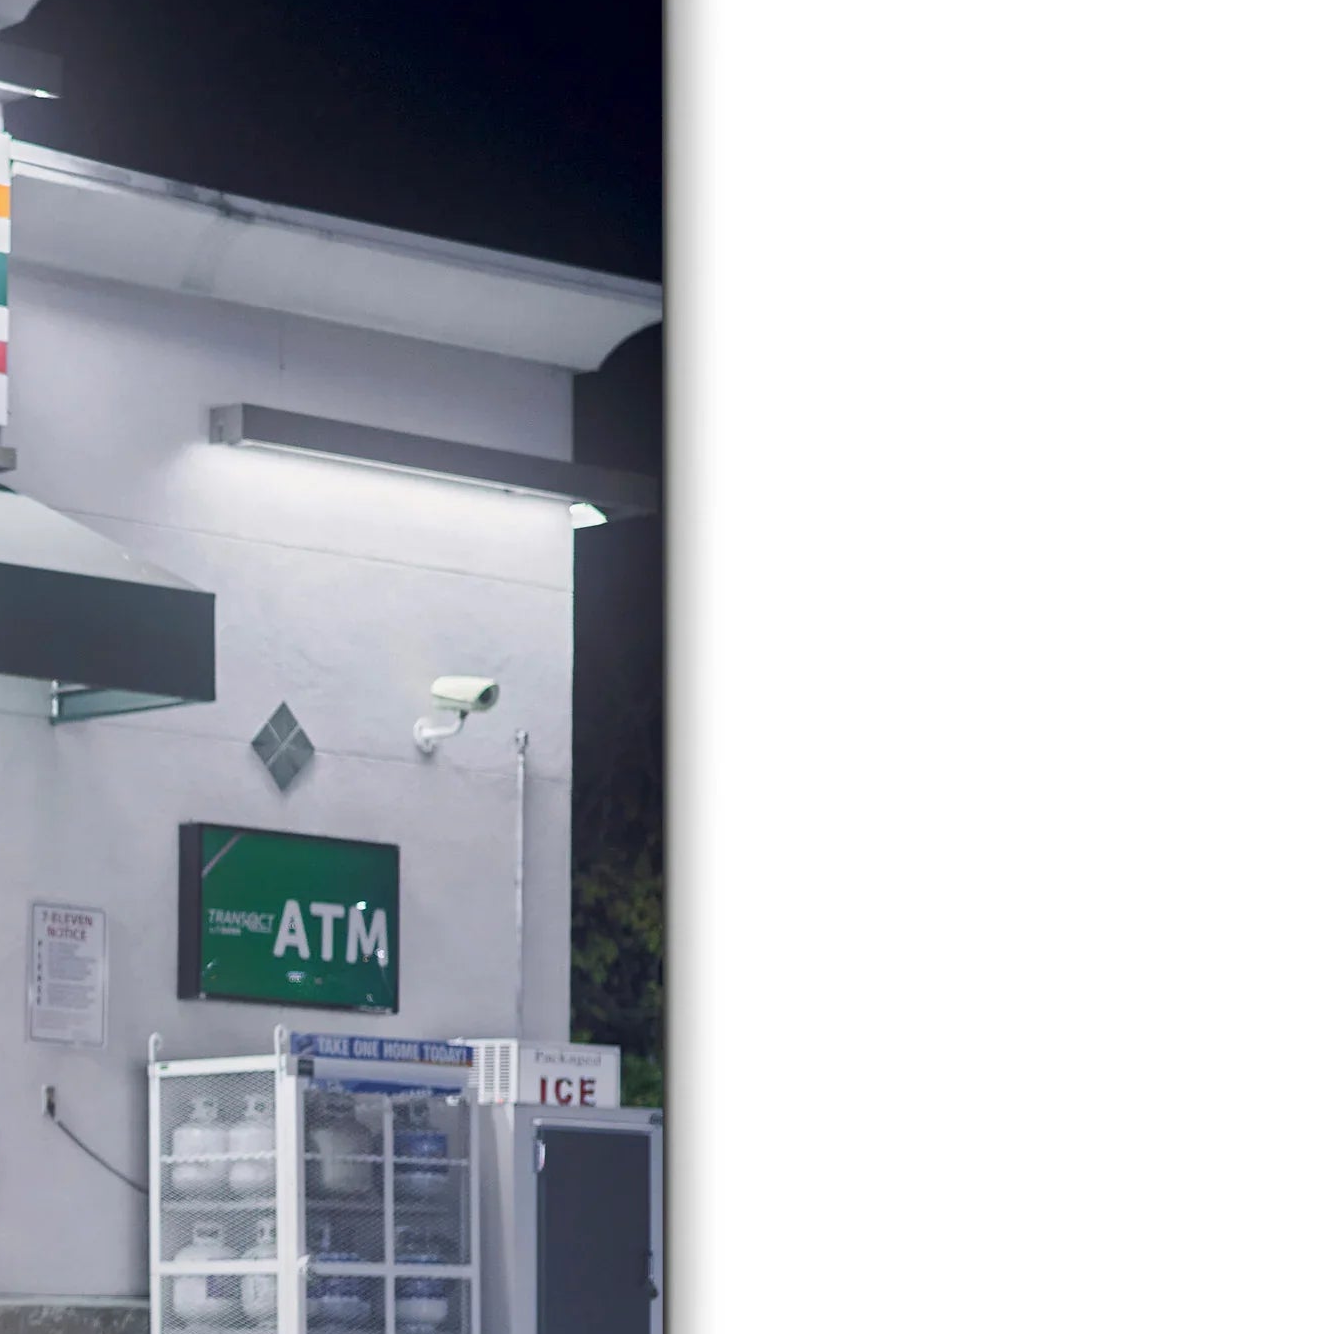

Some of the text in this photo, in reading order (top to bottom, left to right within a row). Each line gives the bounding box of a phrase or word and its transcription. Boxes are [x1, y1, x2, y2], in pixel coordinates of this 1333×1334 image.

[47, 925, 87, 941] NOTICE
[272, 898, 389, 968] ATM
[318, 1035, 467, 1063] TAKE ONE HOME TODAY!
[535, 1050, 602, 1066] Packaged
[539, 1076, 597, 1107] ICE
